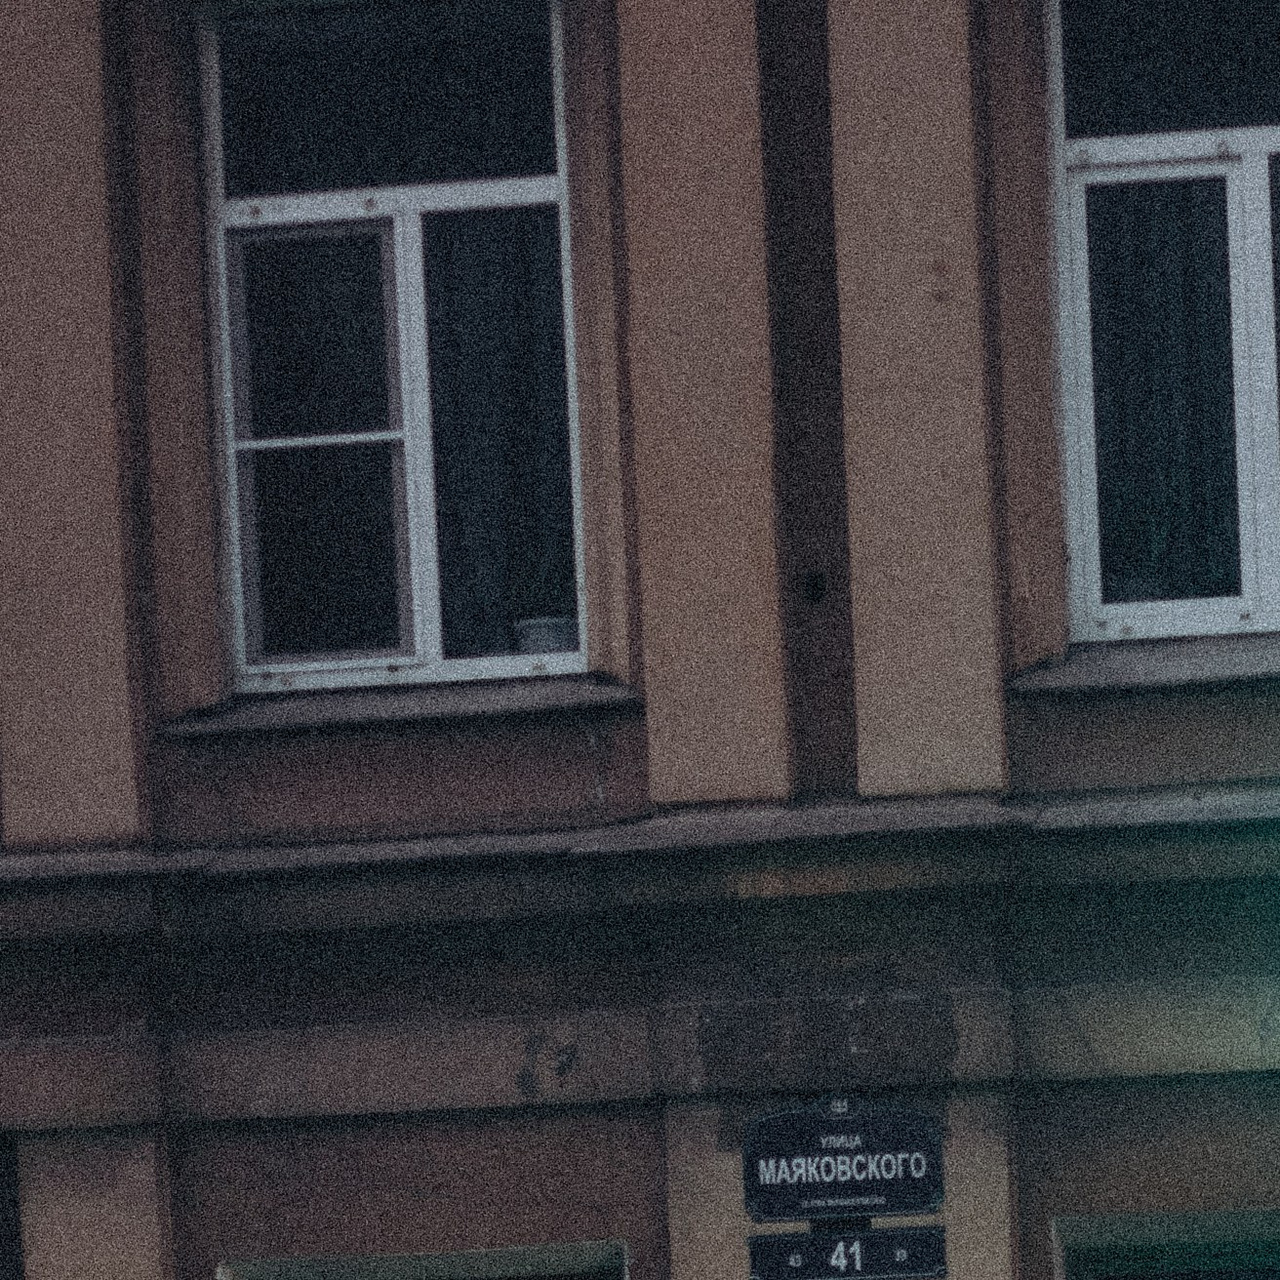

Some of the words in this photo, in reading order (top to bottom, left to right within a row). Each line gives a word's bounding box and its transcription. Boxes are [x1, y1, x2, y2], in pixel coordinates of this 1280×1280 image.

[820, 1134, 862, 1149] УЛИЦА
[758, 1152, 927, 1185] МАЯКОВСКОГО
[830, 1240, 863, 1272] 41
